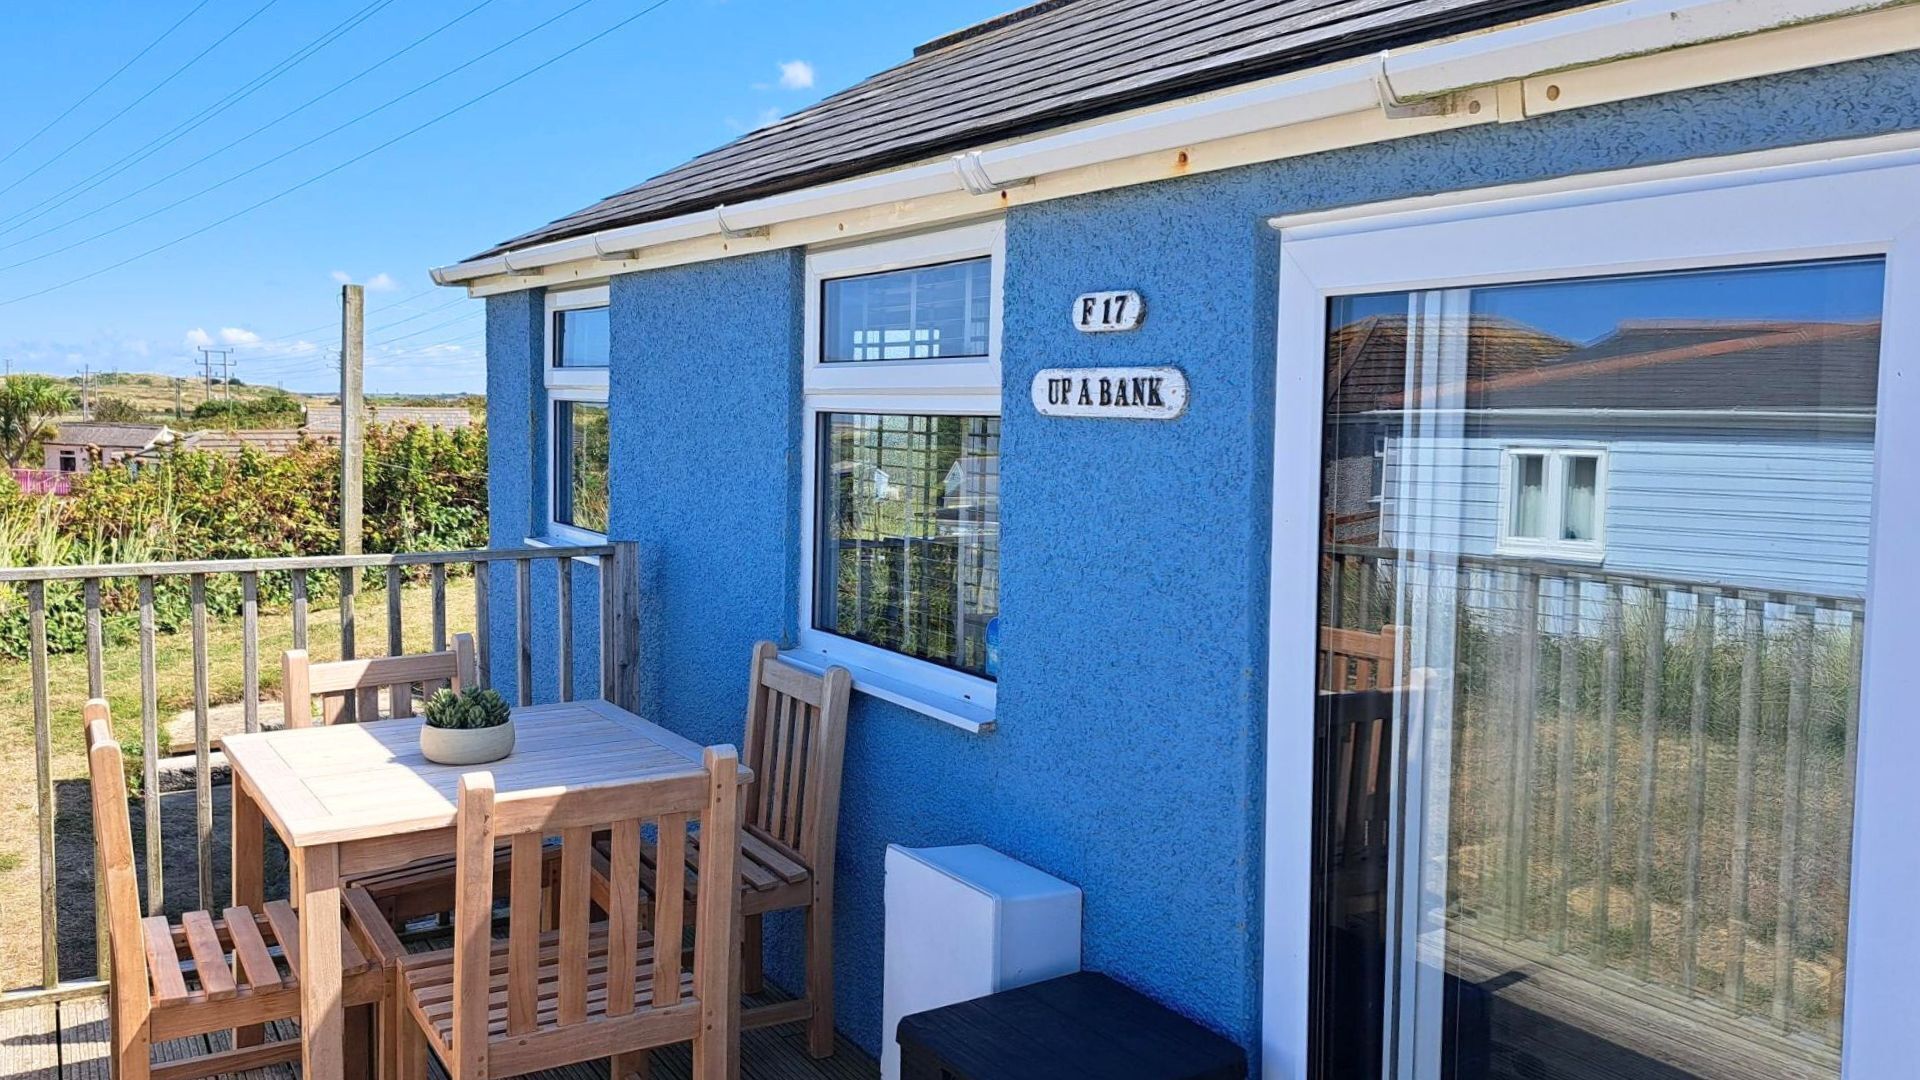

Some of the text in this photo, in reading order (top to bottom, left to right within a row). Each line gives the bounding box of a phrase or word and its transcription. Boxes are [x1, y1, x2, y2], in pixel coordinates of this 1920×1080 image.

[1048, 377, 1165, 407] UP A BANK
